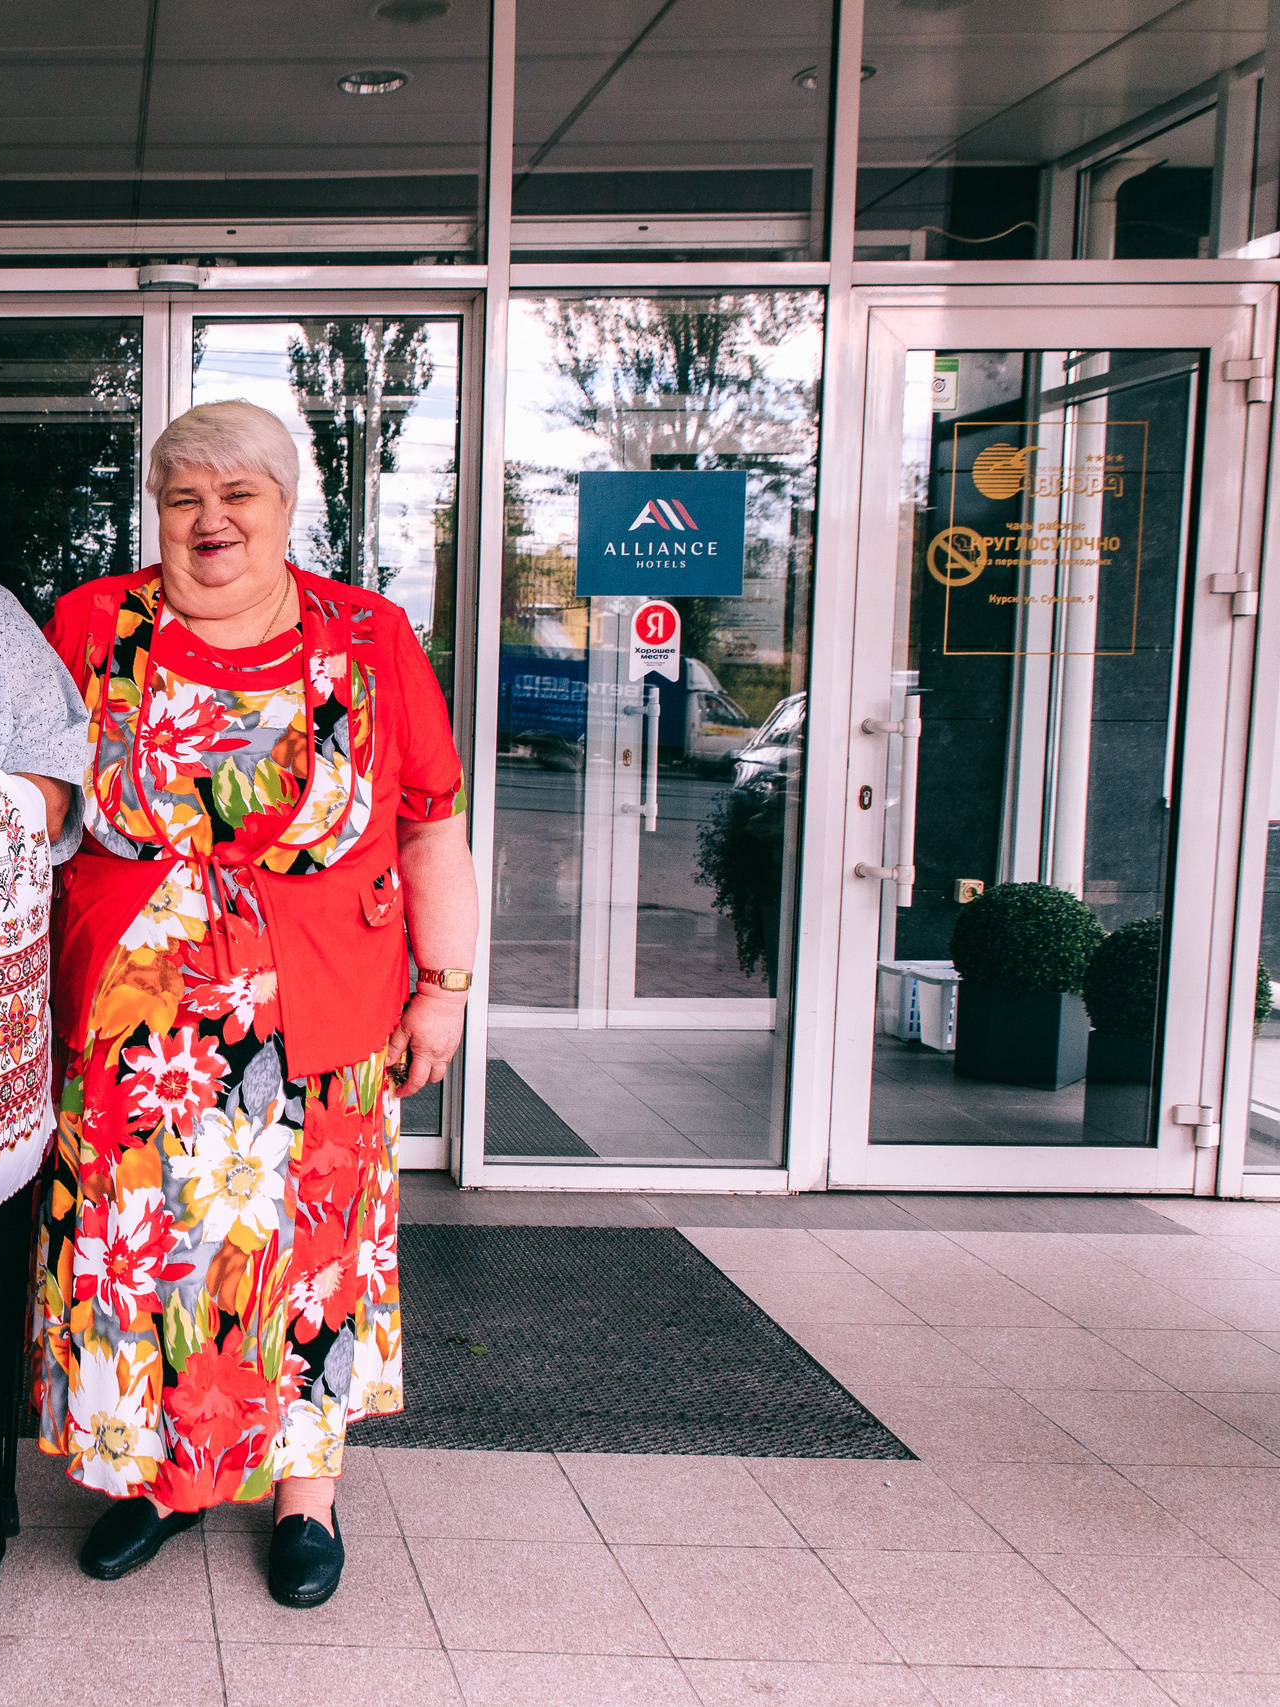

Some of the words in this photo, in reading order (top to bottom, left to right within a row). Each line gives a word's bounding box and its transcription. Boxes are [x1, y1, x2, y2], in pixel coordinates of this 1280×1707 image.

[970, 536, 1121, 551] КРУГЛОСУТОЧНО
[603, 541, 718, 556] ALLIANCE
[636, 560, 687, 569] HOTELS
[975, 557, 993, 566] бз
[1088, 594, 1095, 603] 9
[646, 612, 664, 638] Я
[634, 647, 676, 655] Хорошее
